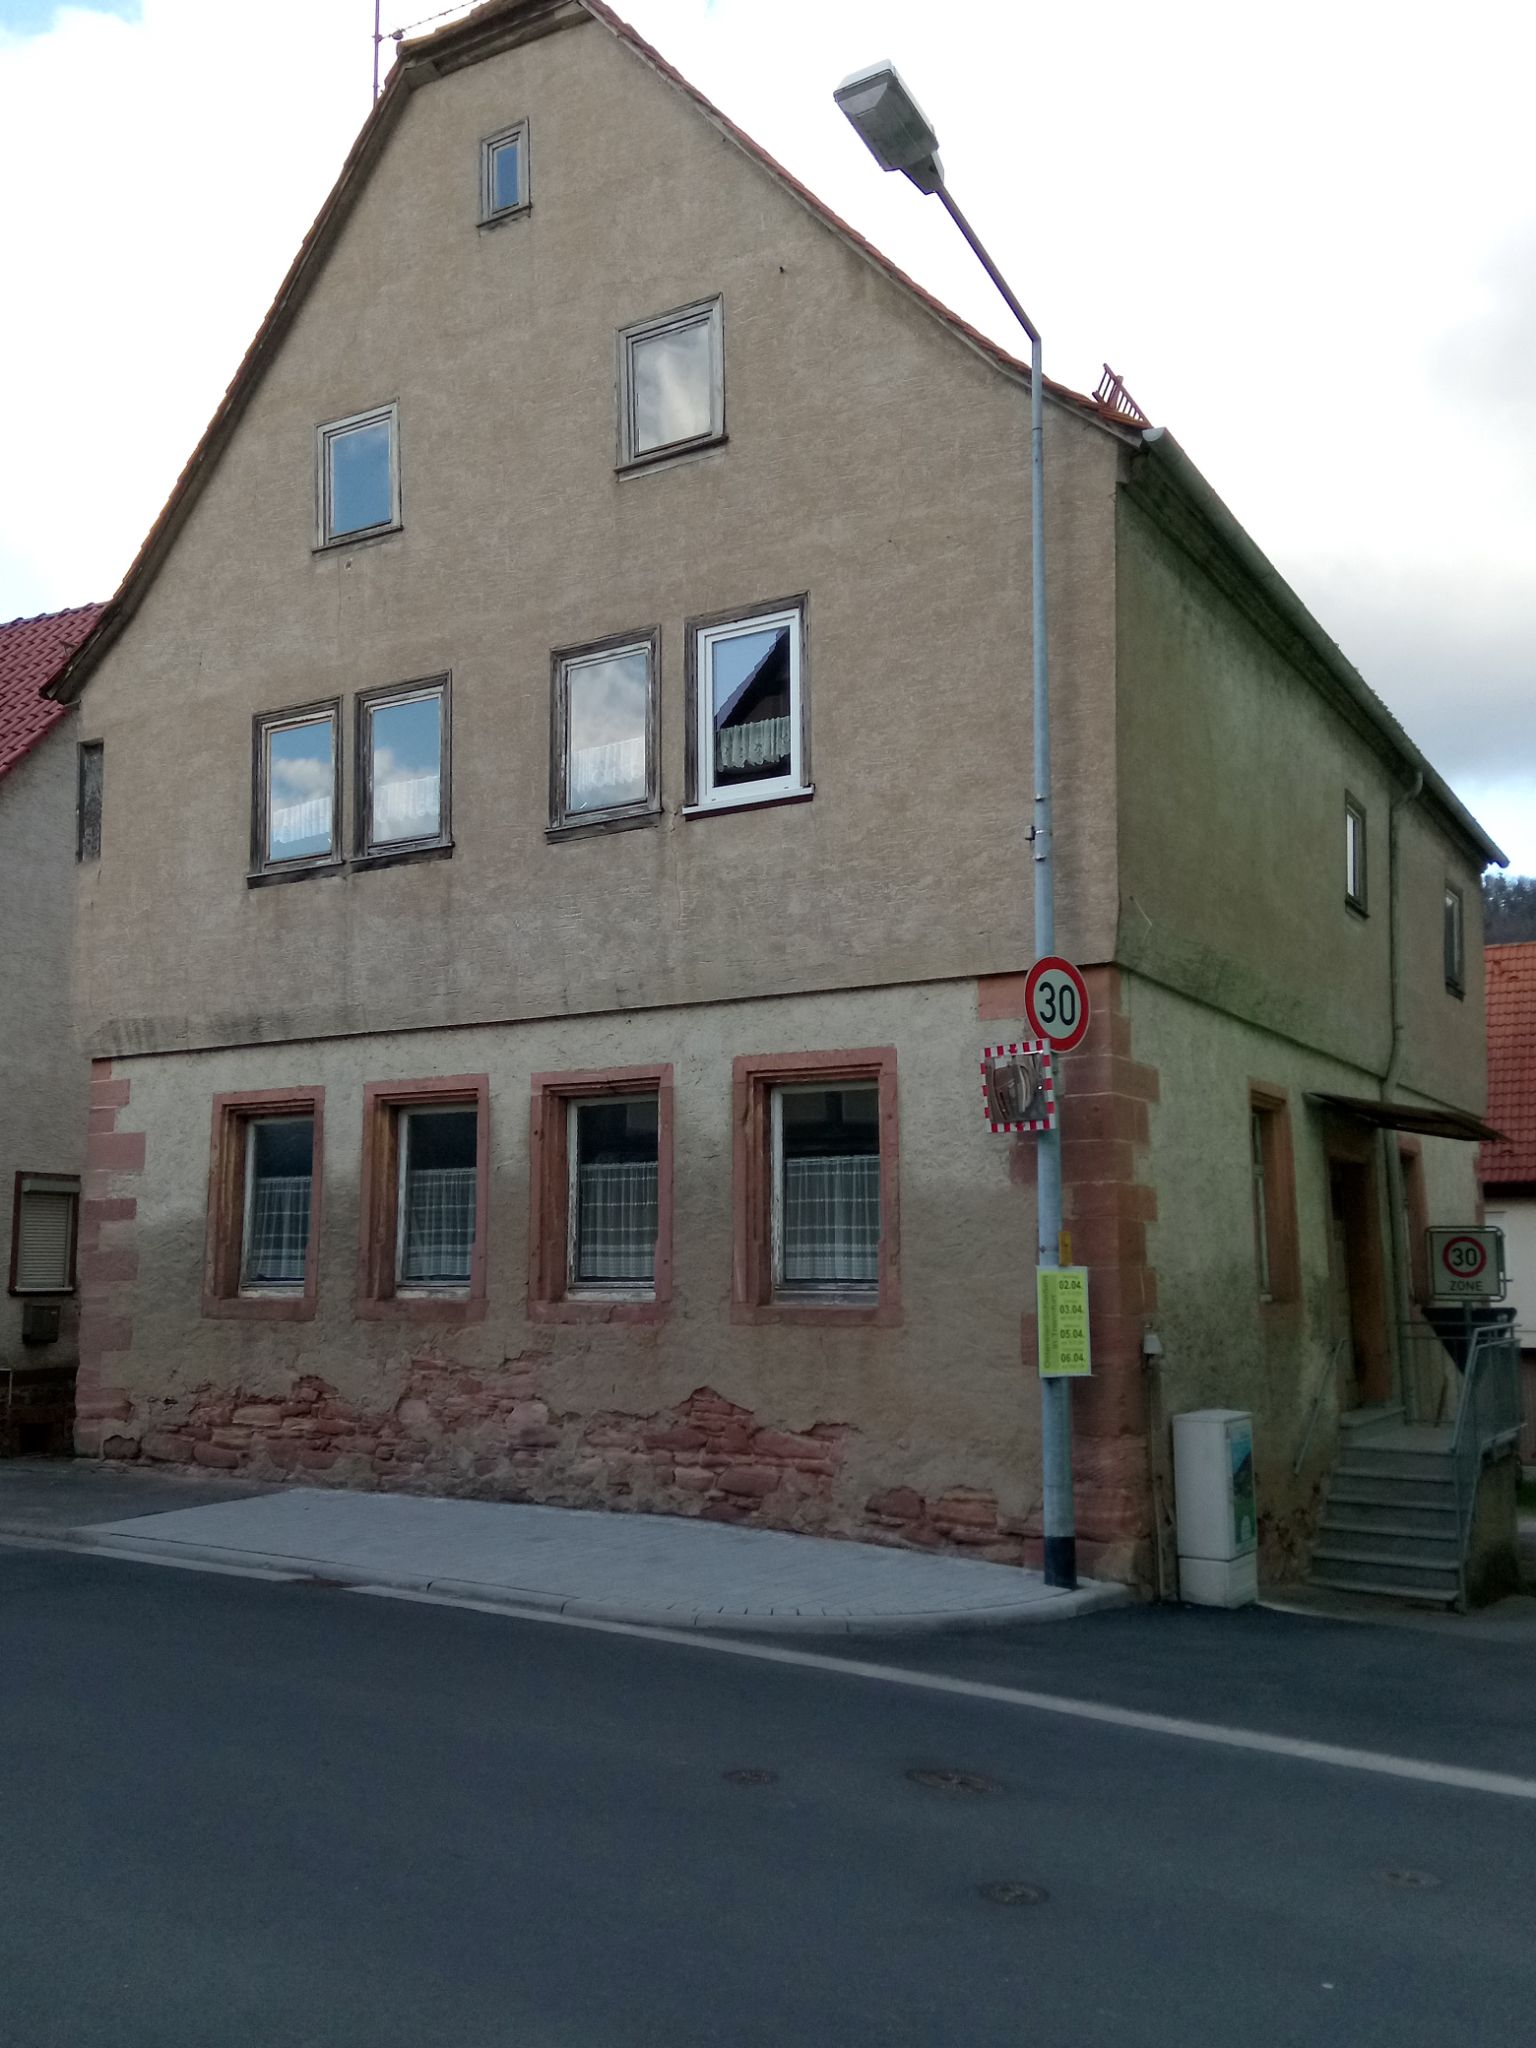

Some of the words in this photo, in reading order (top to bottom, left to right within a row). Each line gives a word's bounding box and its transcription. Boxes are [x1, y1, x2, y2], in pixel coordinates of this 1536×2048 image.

[1039, 981, 1076, 1026] 30
[1452, 1247, 1478, 1267] 30
[1059, 1280, 1083, 1290] 02.04.
[1449, 1280, 1484, 1292] ZONE
